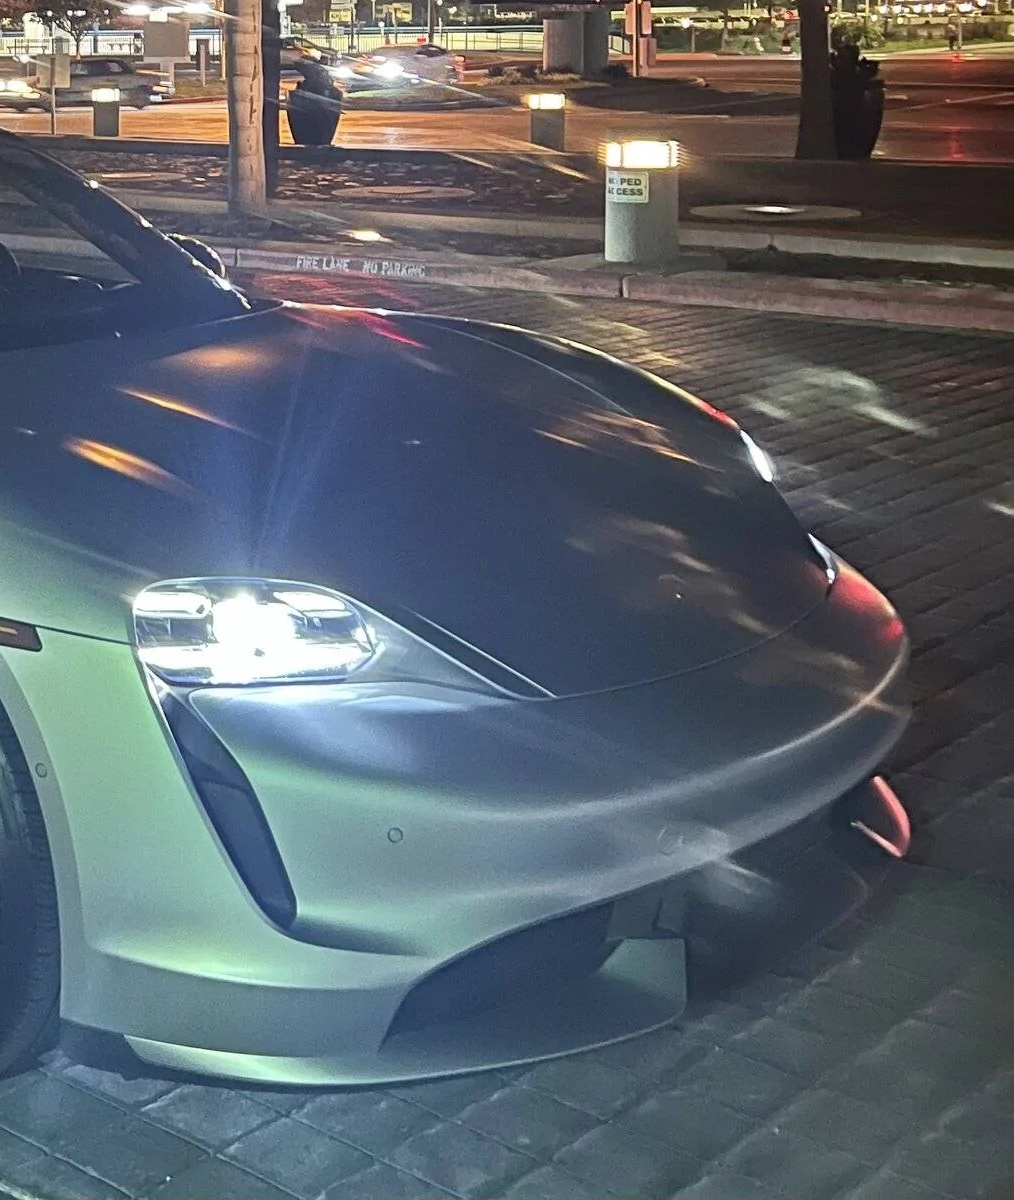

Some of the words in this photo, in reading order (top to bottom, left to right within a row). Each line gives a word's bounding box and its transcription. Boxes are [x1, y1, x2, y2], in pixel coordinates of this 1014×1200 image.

[620, 177, 642, 186] PED
[297, 255, 319, 270] FIRE
[322, 256, 351, 272] LANE
[362, 261, 378, 275] NO
[381, 261, 426, 278] PARKING
